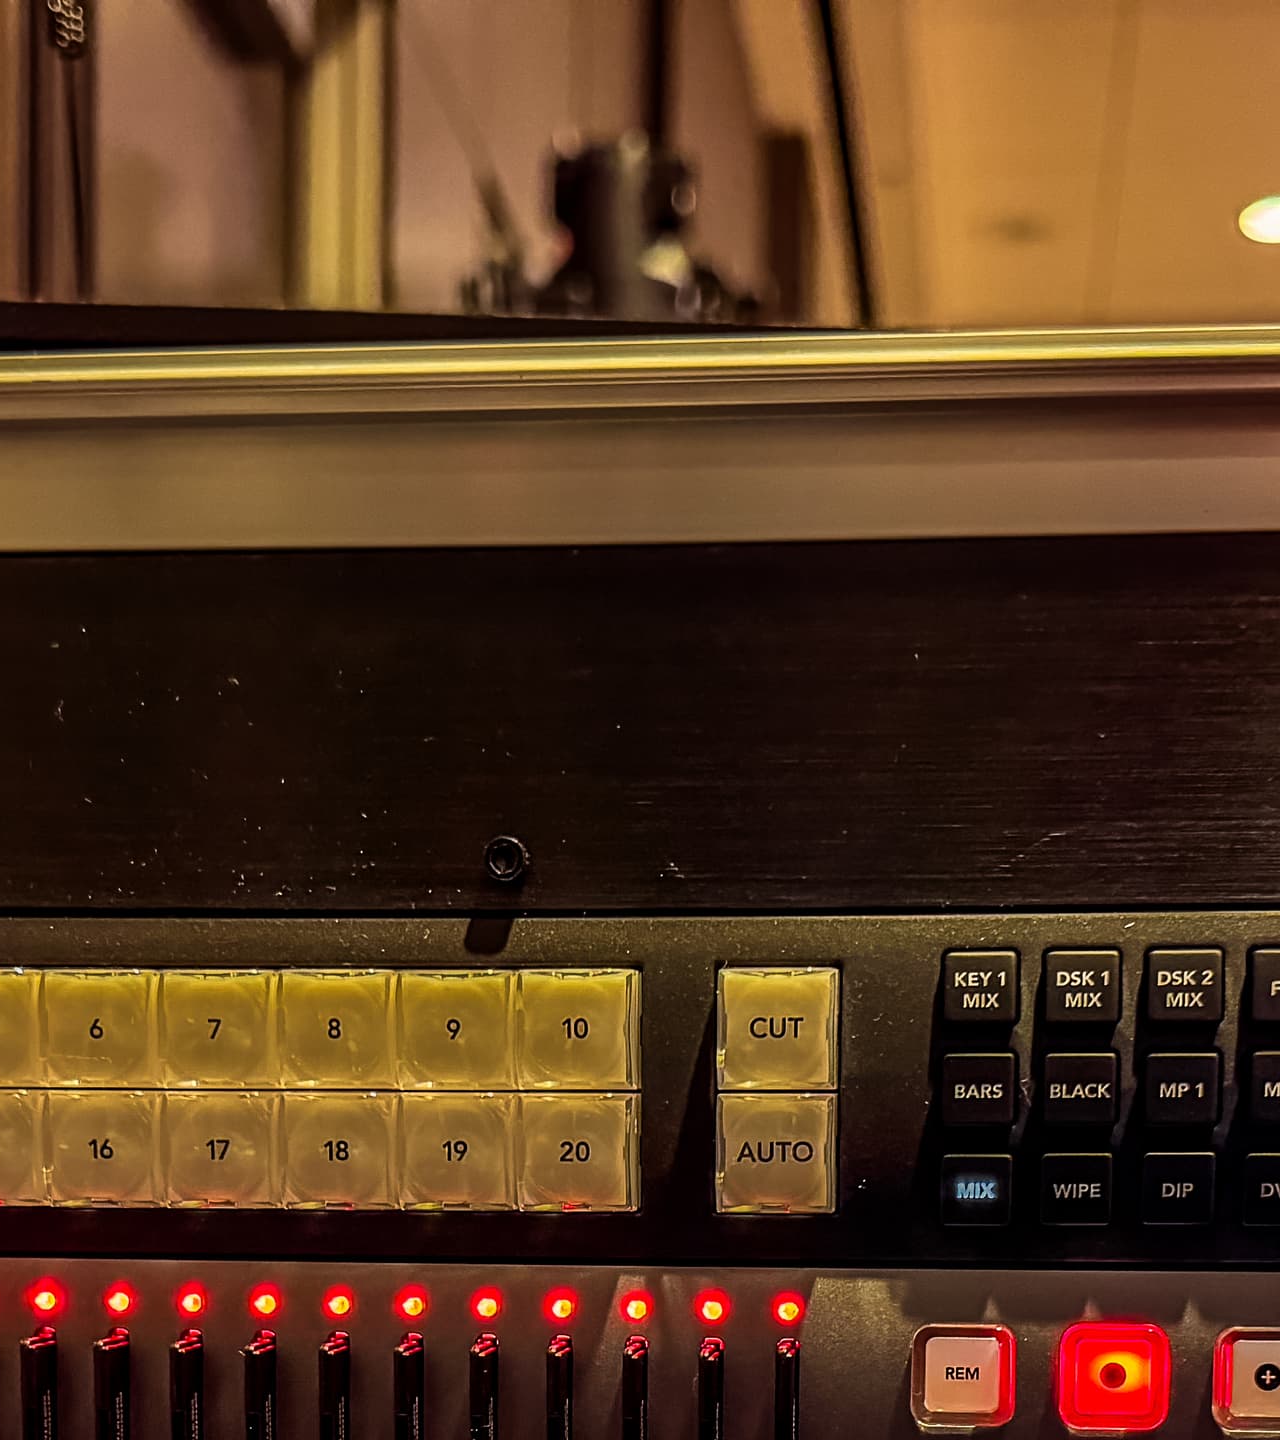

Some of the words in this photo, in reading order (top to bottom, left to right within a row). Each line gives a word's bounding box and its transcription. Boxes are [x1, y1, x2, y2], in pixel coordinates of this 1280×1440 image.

[954, 971, 993, 987] KEY
[997, 971, 1006, 987] 1
[1056, 970, 1095, 987] DSK
[1101, 970, 1111, 987] 1
[1157, 970, 1197, 986] DSK
[1201, 969, 1214, 986] 2
[963, 992, 999, 1009] MIX
[1065, 992, 1102, 1008] MIX
[1166, 991, 1203, 1008] MIX
[90, 1019, 103, 1039] 6
[208, 1019, 221, 1039] 7
[328, 1018, 340, 1039] 8
[447, 1019, 460, 1039] 9
[562, 1018, 588, 1038] 10
[750, 1018, 803, 1038] CUT
[954, 1083, 1003, 1099] BARS
[1049, 1082, 1111, 1099] BLACK
[1159, 1082, 1190, 1098] MP
[1195, 1082, 1204, 1098] 1
[89, 1139, 113, 1159] 16
[206, 1140, 229, 1160] 17
[324, 1141, 349, 1161] 18
[443, 1141, 467, 1161] 19
[560, 1142, 589, 1162] 20
[737, 1142, 813, 1162] AUTO
[956, 1181, 996, 1199] MIX
[1053, 1183, 1101, 1199] WIPE
[1161, 1182, 1194, 1199] DIP
[945, 1366, 980, 1381] REM
